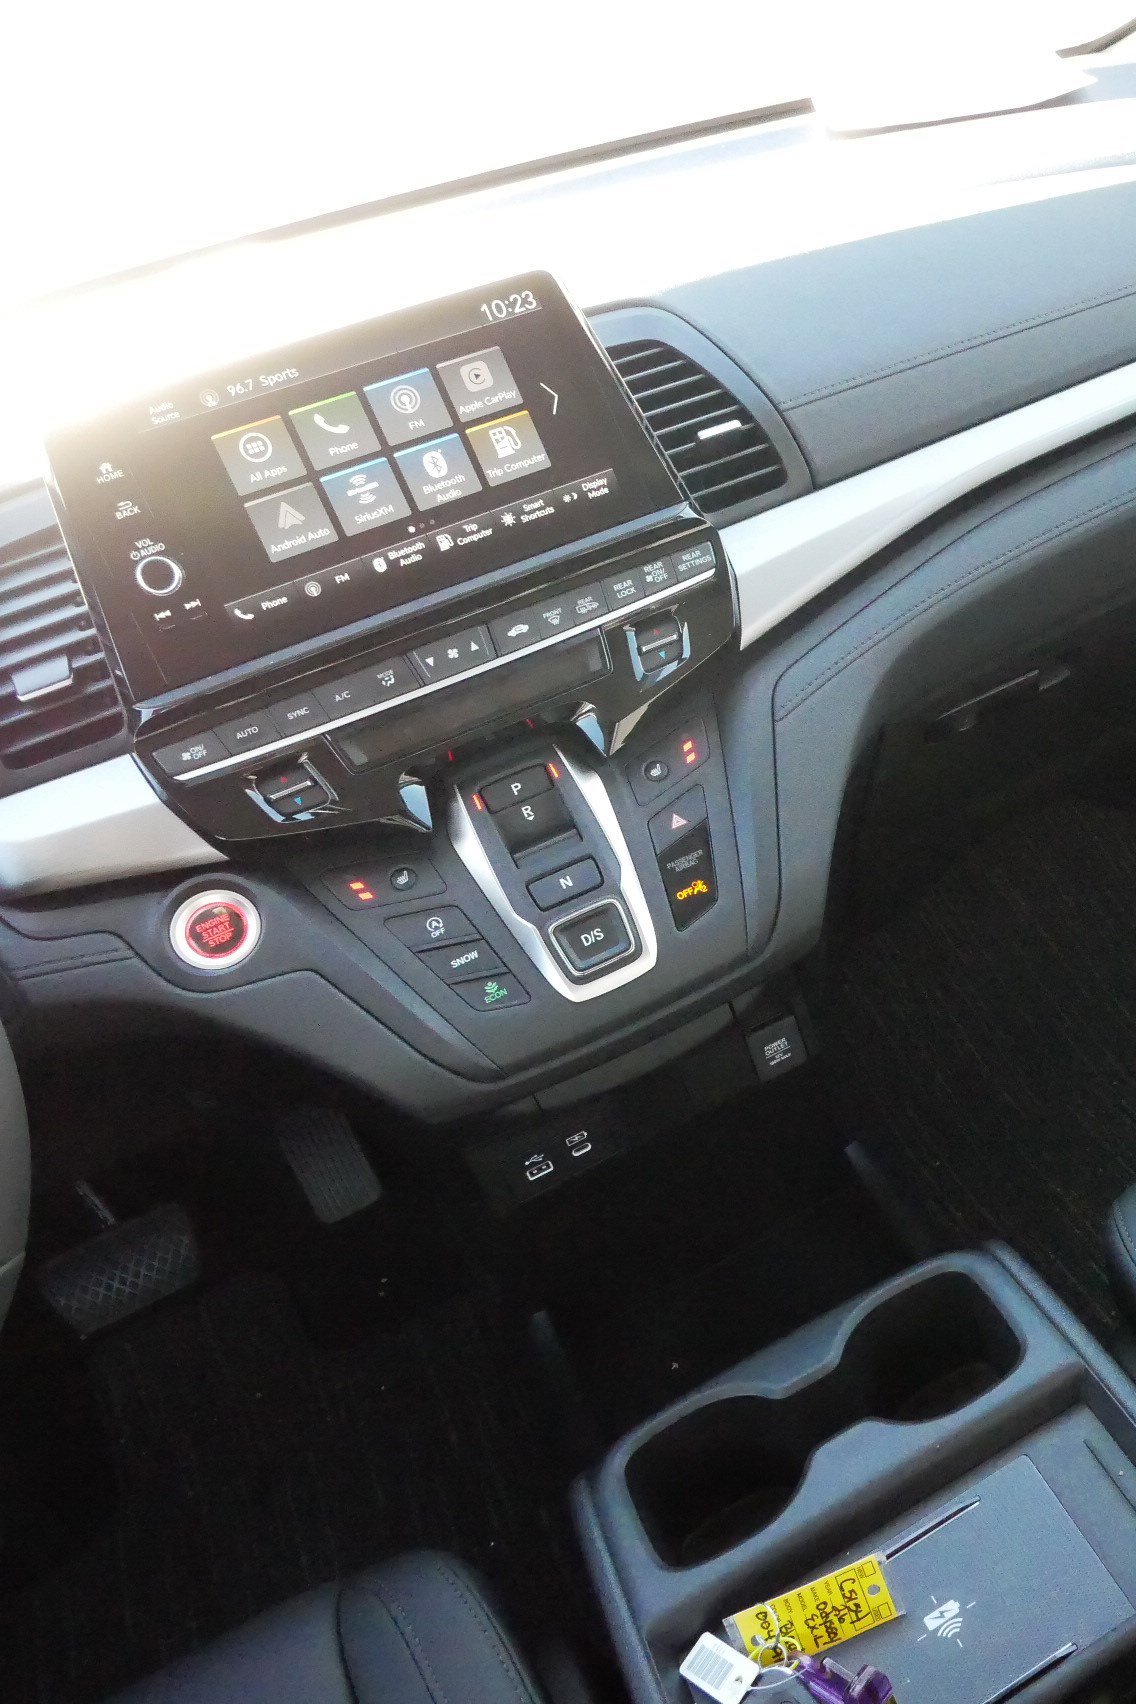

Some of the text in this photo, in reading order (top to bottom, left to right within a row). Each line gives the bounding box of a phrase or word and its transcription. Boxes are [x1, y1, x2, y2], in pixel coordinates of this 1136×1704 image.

[480, 291, 537, 321] 10:23
[226, 367, 299, 396] 96.7 Sports
[150, 402, 174, 415] Audio
[459, 389, 516, 415] Apple CarPlay
[152, 410, 180, 425] Source
[408, 419, 425, 431] FM
[329, 441, 358, 456] Phone
[487, 453, 546, 479] Trip Computer
[96, 470, 124, 484] HOME
[250, 464, 288, 483] All Apps
[422, 473, 466, 495] Bluetooth
[582, 477, 607, 492] Display
[437, 489, 462, 503] Audio
[587, 487, 609, 500] Mode
[115, 505, 141, 520] BACK
[523, 499, 544, 512] Smart
[354, 504, 395, 525] SiriusXM
[520, 506, 555, 523] Shortcuts
[462, 523, 478, 533] Trip
[135, 538, 154, 549] VOL
[271, 527, 330, 554] Android Auto
[457, 528, 493, 546] Computer
[140, 543, 165, 557] AUDIO
[387, 542, 425, 561] Bluetooth
[682, 550, 702, 562] REAR
[400, 553, 423, 567] Audio
[677, 554, 712, 572] SETTINGS
[643, 561, 664, 574] REAR
[652, 568, 665, 579] ON/
[335, 573, 350, 584] FM
[654, 573, 668, 583] OFF
[613, 579, 633, 592] REAR
[617, 587, 636, 599] LOCK
[261, 595, 288, 611] Phone
[577, 596, 593, 606] REAR
[542, 607, 562, 619] FRONT
[376, 669, 394, 680] MODE
[334, 690, 351, 702] A/C
[287, 707, 310, 720] SYNC
[236, 726, 259, 740] AUTO
[193, 750, 208, 761] OFF
[511, 783, 522, 795] P
[521, 805, 534, 818] R
[666, 849, 704, 870] PASSENGER
[675, 859, 699, 873] AIRBAG
[559, 875, 573, 889] N
[676, 887, 693, 900] OFF
[195, 913, 230, 933] ENGINE
[202, 921, 230, 939] START
[208, 931, 233, 947] STOP
[431, 927, 445, 938] OFF
[581, 928, 604, 947] D/S
[451, 950, 479, 968] SNOW
[484, 987, 508, 1004] ECON
[764, 1037, 785, 1051] POWER
[765, 1041, 788, 1056] OUTLET
[824, 1580, 833, 1595] YEAR
[810, 1587, 819, 1603] MAKE
